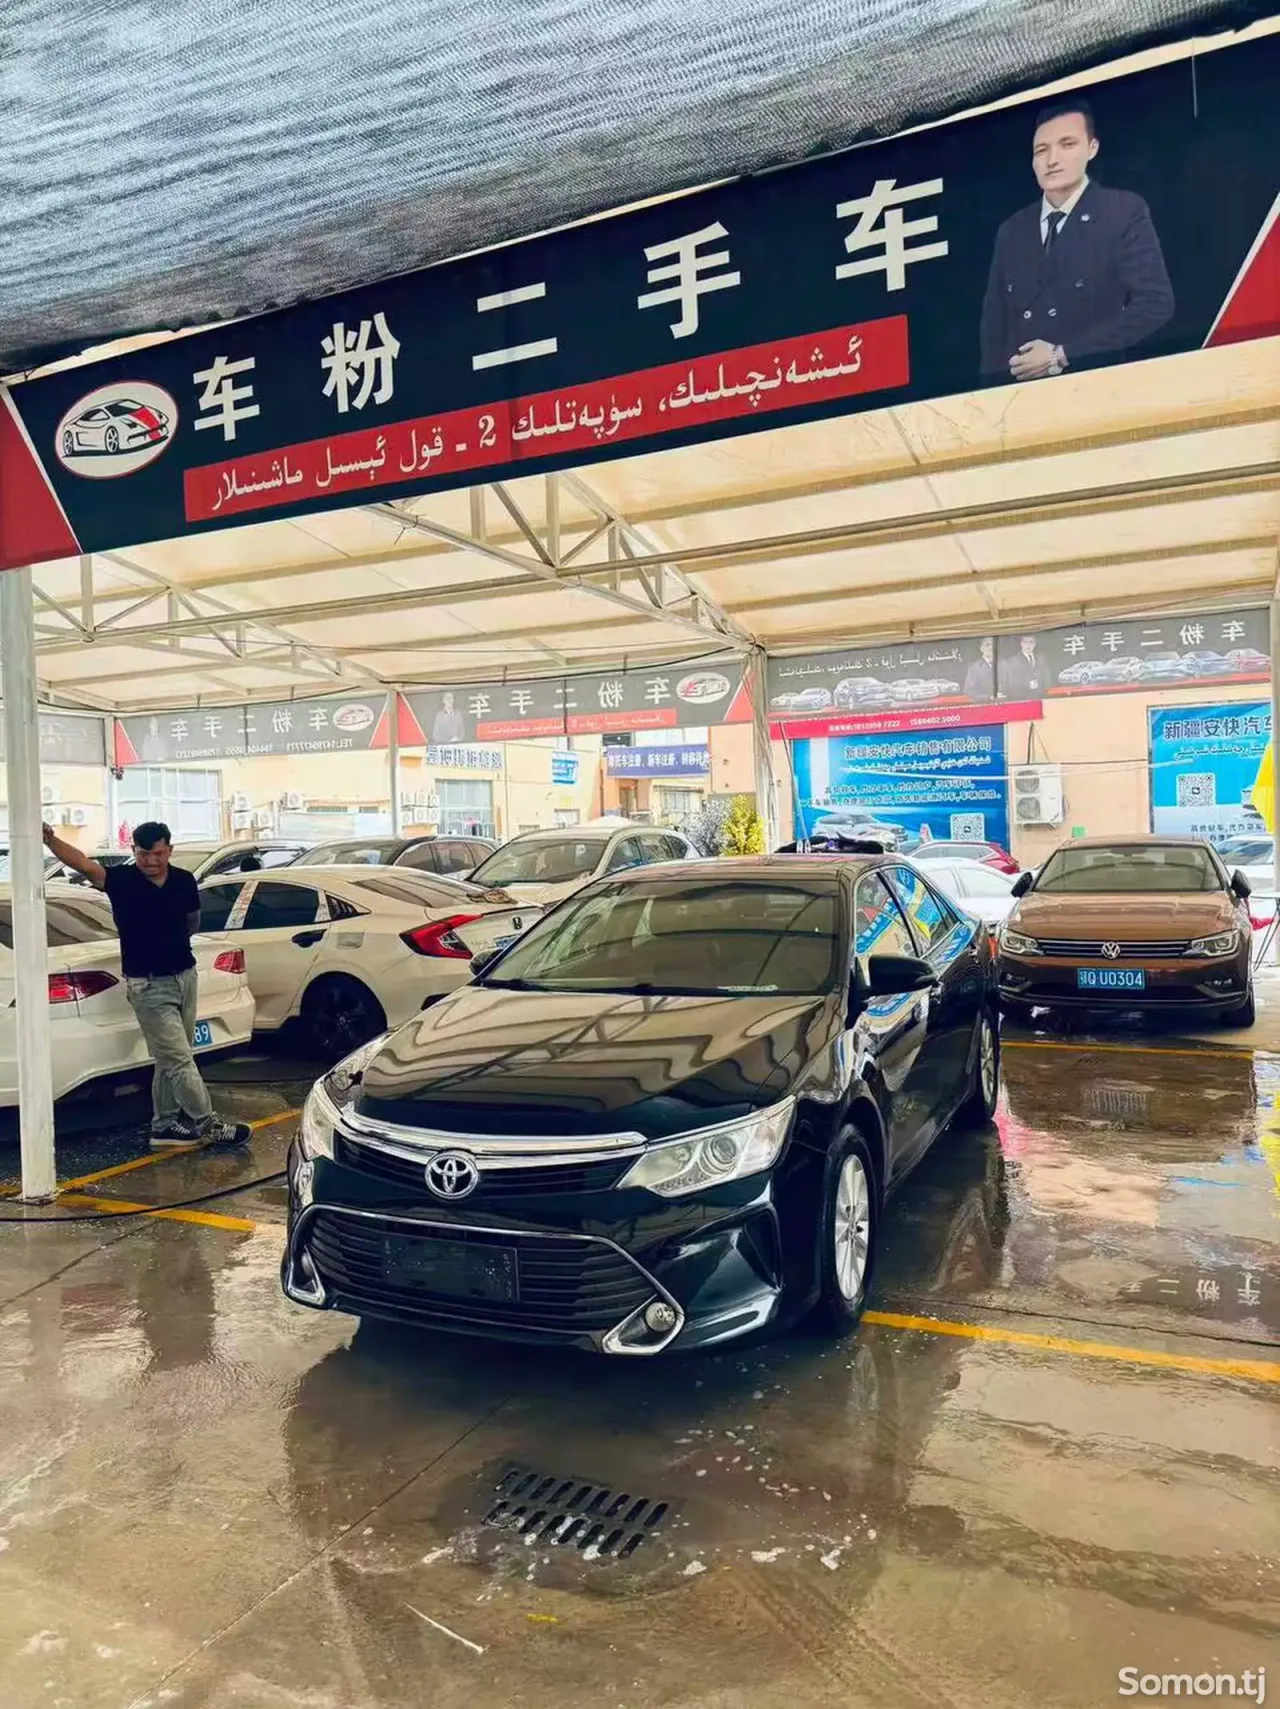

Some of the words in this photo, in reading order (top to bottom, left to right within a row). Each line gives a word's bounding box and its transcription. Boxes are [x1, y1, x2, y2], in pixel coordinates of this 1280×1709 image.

[193, 176, 949, 442] 车粉二手车
[477, 415, 497, 449] 2
